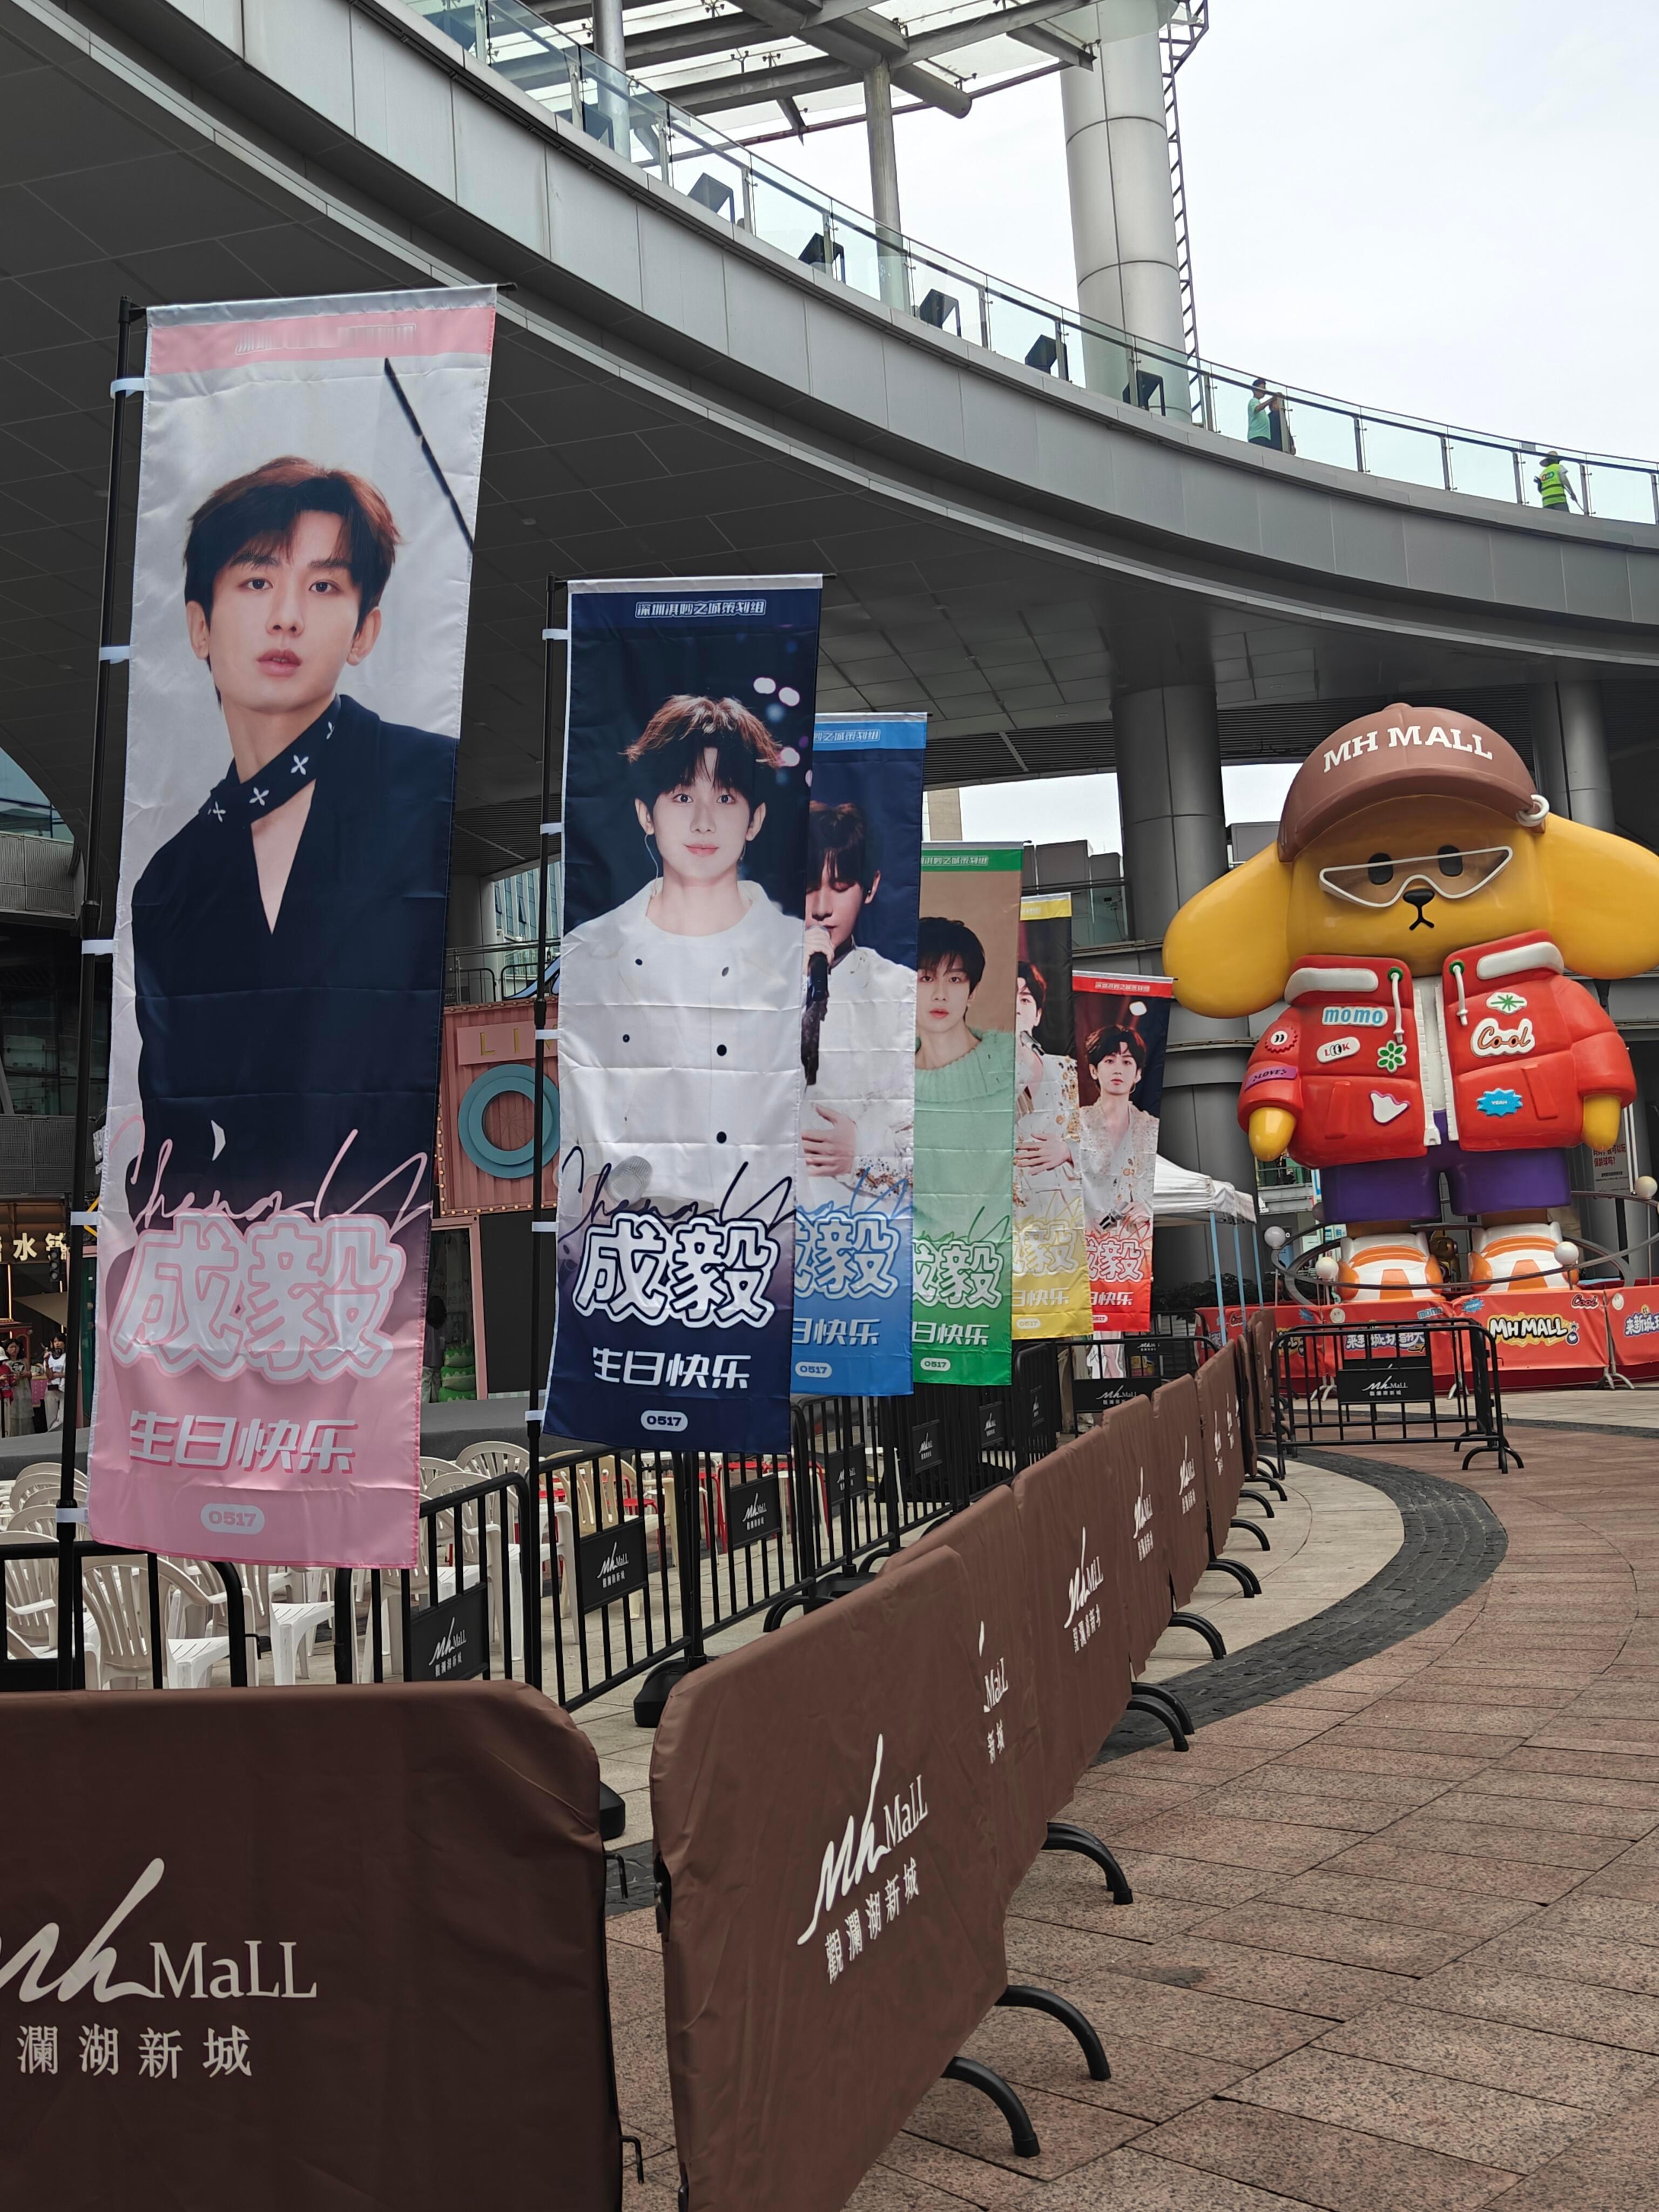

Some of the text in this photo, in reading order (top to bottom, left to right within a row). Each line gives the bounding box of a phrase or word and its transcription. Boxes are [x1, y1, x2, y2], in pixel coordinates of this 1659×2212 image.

[1324, 726, 1493, 773] MH MALL
[1324, 1008, 1383, 1024] momo
[1478, 1026, 1531, 1049] Cool
[572, 1211, 781, 1328] 成毅
[794, 1210, 901, 1300] 毅
[1012, 1219, 1079, 1278] 毅
[1521, 1317, 1568, 1338] MALL
[593, 1347, 752, 1390] 生日快乐
[799, 1365, 828, 1374] 0517
[130, 1410, 358, 1474] 生日快乐
[646, 1415, 682, 1427] 0517
[208, 1510, 256, 1528] 0517
[825, 1856, 919, 1985] 觀瀾湖新城
[17, 2023, 252, 2079] 瀾湖新城
